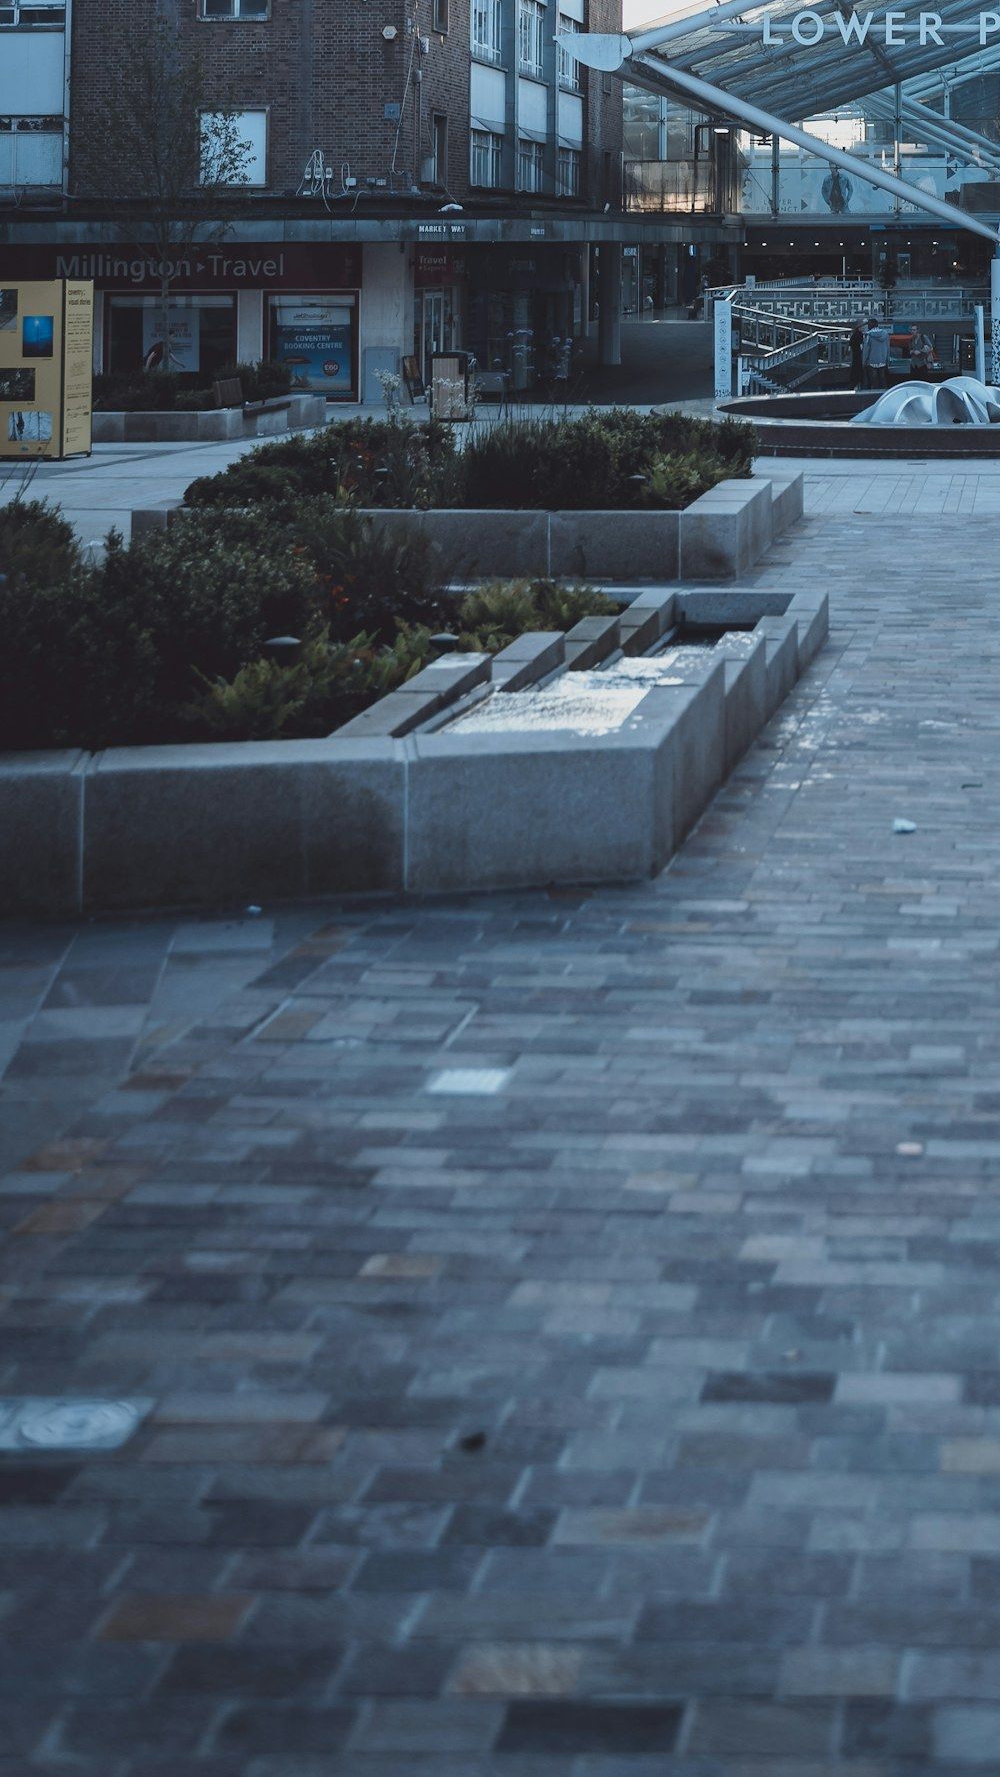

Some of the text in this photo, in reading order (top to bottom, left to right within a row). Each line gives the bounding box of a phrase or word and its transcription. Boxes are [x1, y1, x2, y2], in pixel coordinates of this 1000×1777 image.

[762, 11, 946, 46] LOWER
[419, 225, 465, 233] MARKET WAY
[419, 255, 447, 264] Travel
[55, 253, 285, 283] Millington Travel
[295, 334, 331, 342] COVENTRY
